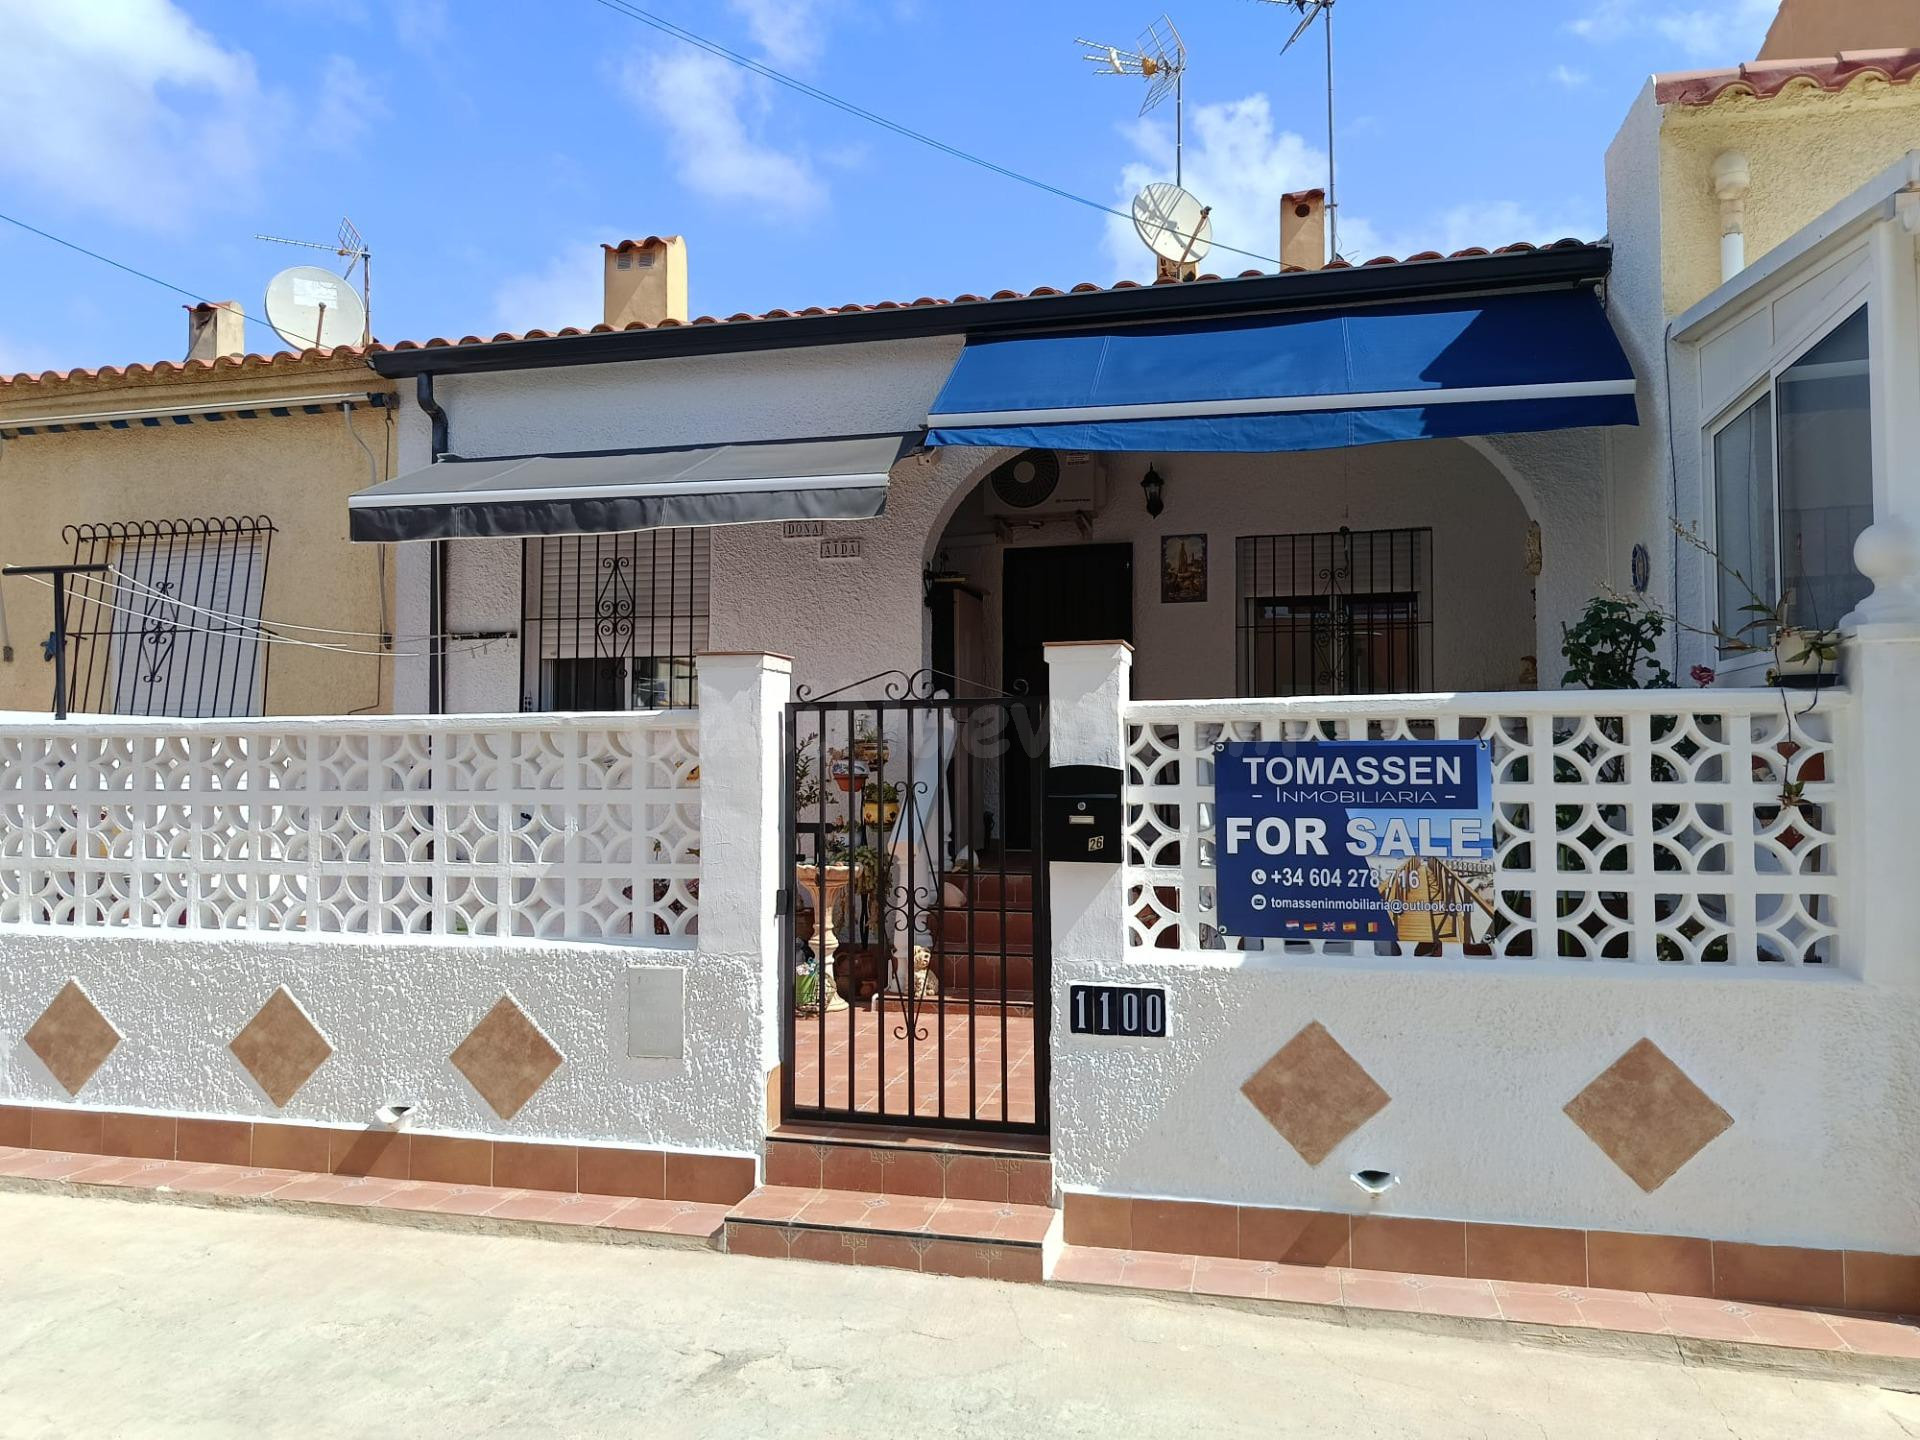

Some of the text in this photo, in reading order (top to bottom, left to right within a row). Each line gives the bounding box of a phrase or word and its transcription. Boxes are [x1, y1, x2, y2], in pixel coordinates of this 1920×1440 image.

[824, 543, 856, 556] AIDA
[1243, 756, 1461, 786] TOMASSEN
[1089, 837, 1103, 850] 26
[1226, 817, 1482, 858] FOR SALE
[1271, 868, 1421, 890] +34 604 278 716
[1271, 896, 1475, 913] tomasseninmobiliaria@outlook.com
[1076, 990, 1162, 1033] 1100
